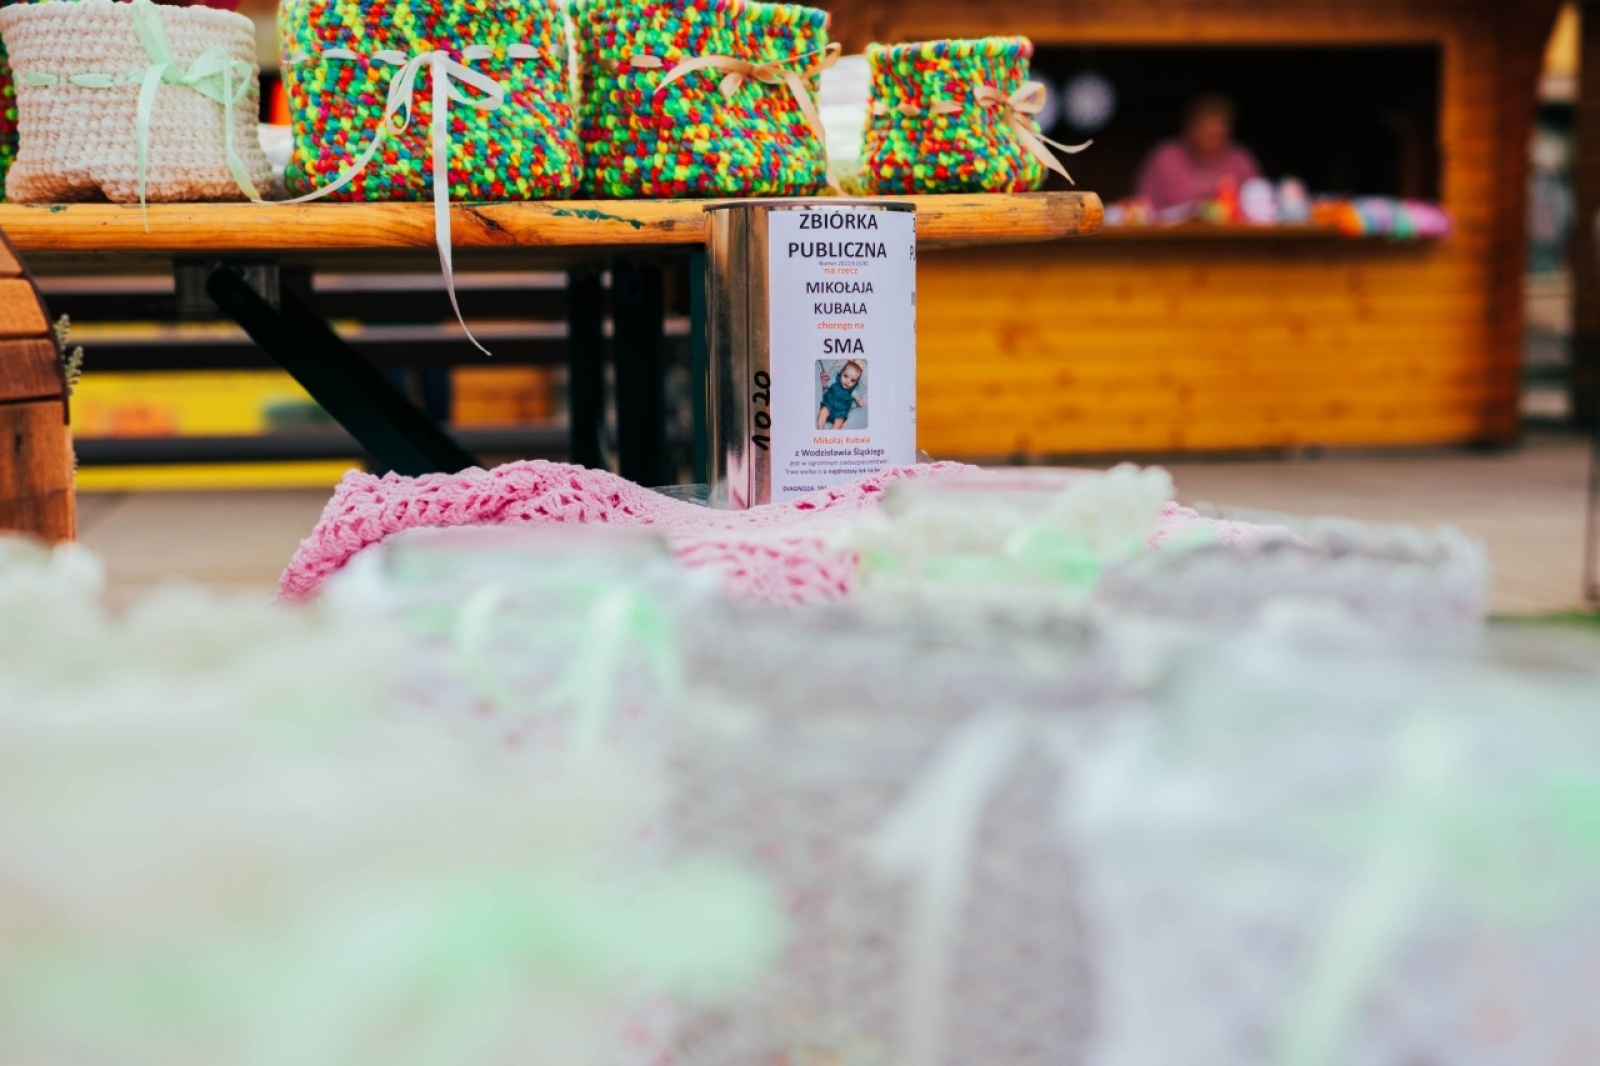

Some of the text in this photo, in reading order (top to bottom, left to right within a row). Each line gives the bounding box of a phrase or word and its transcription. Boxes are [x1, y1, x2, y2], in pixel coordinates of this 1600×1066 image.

[799, 211, 878, 230] ZBIÓRKA
[788, 242, 888, 258] PUBLICZNA
[806, 281, 874, 294] MIKOŁAJA
[814, 302, 868, 315] KUBALA
[817, 321, 865, 331] chorego na
[823, 338, 865, 354] SMA
[813, 436, 871, 445] Mikołaj Kubala
[801, 448, 852, 457] Wodzisławia
[853, 446, 885, 457] Śląskiego
[789, 460, 801, 468] jest
